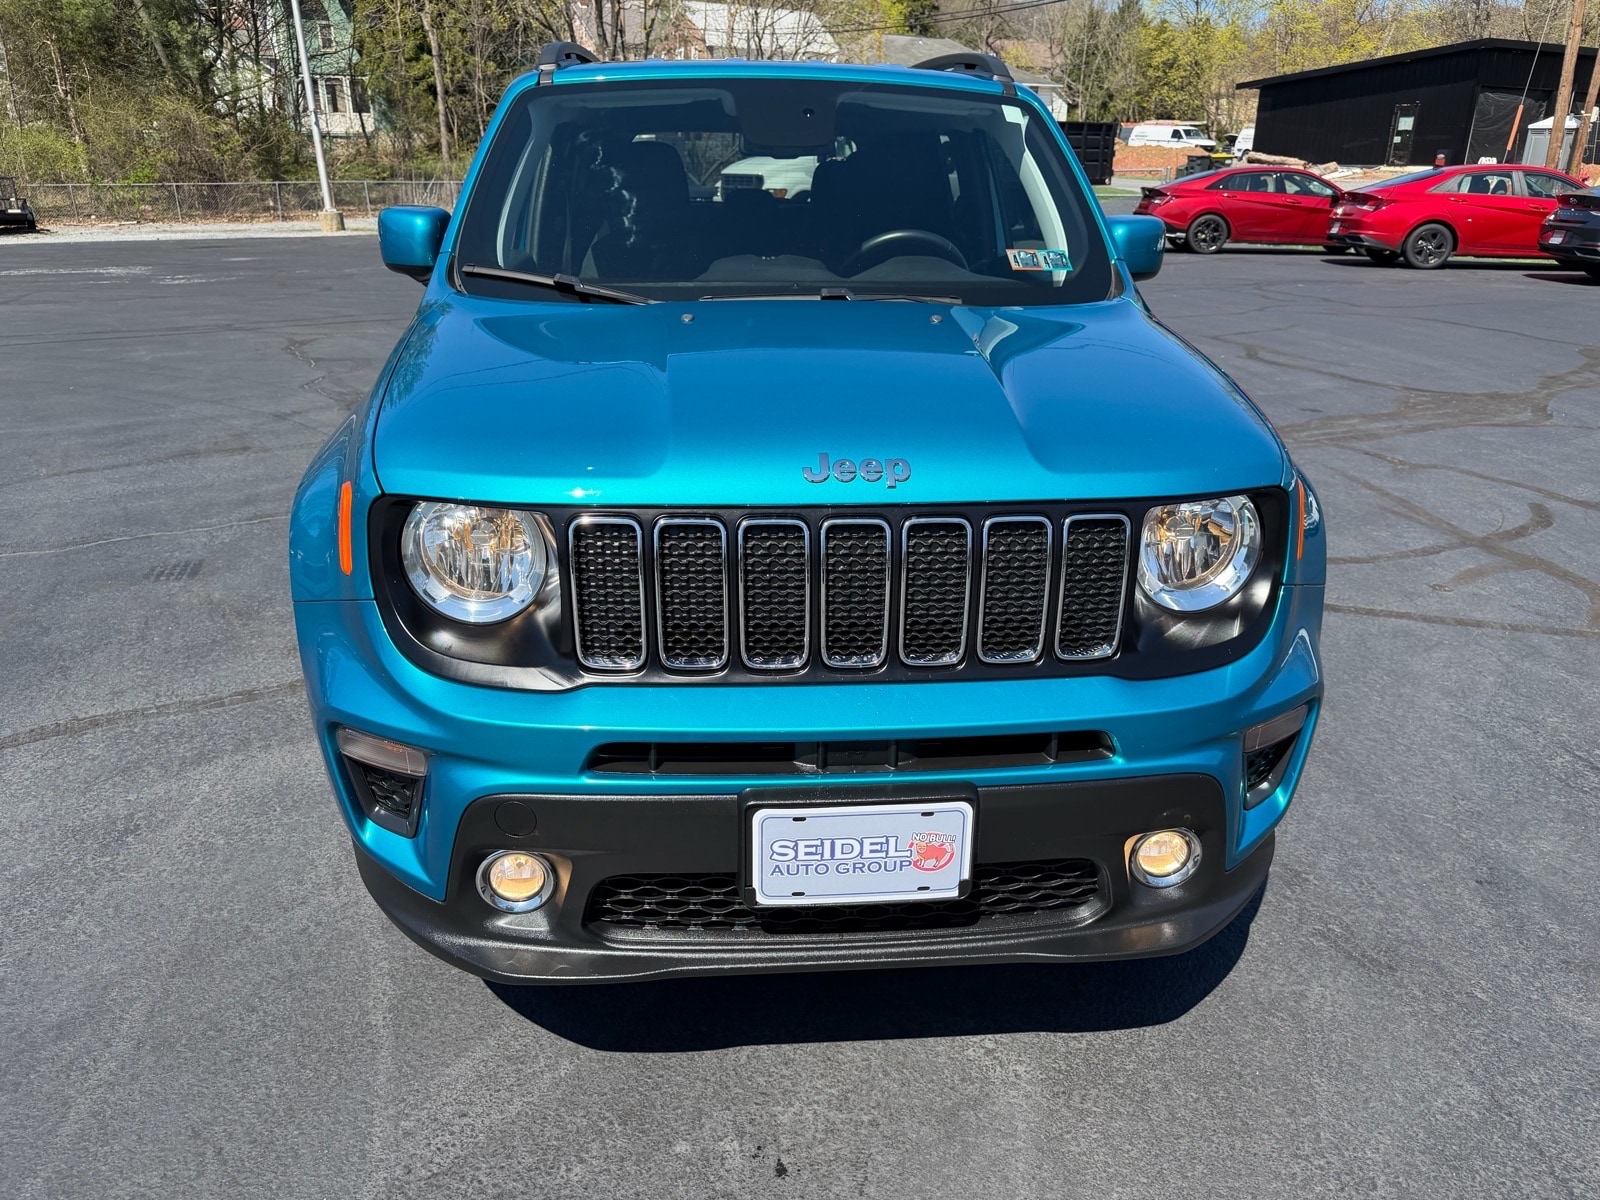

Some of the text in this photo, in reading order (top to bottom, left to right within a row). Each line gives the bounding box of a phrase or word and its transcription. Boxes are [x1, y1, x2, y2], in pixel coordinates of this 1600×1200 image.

[802, 453, 911, 489] Jeep
[912, 832, 956, 843] NO BULL!
[770, 835, 913, 863] SEIDEL
[770, 860, 913, 876] AUTO GROUP
